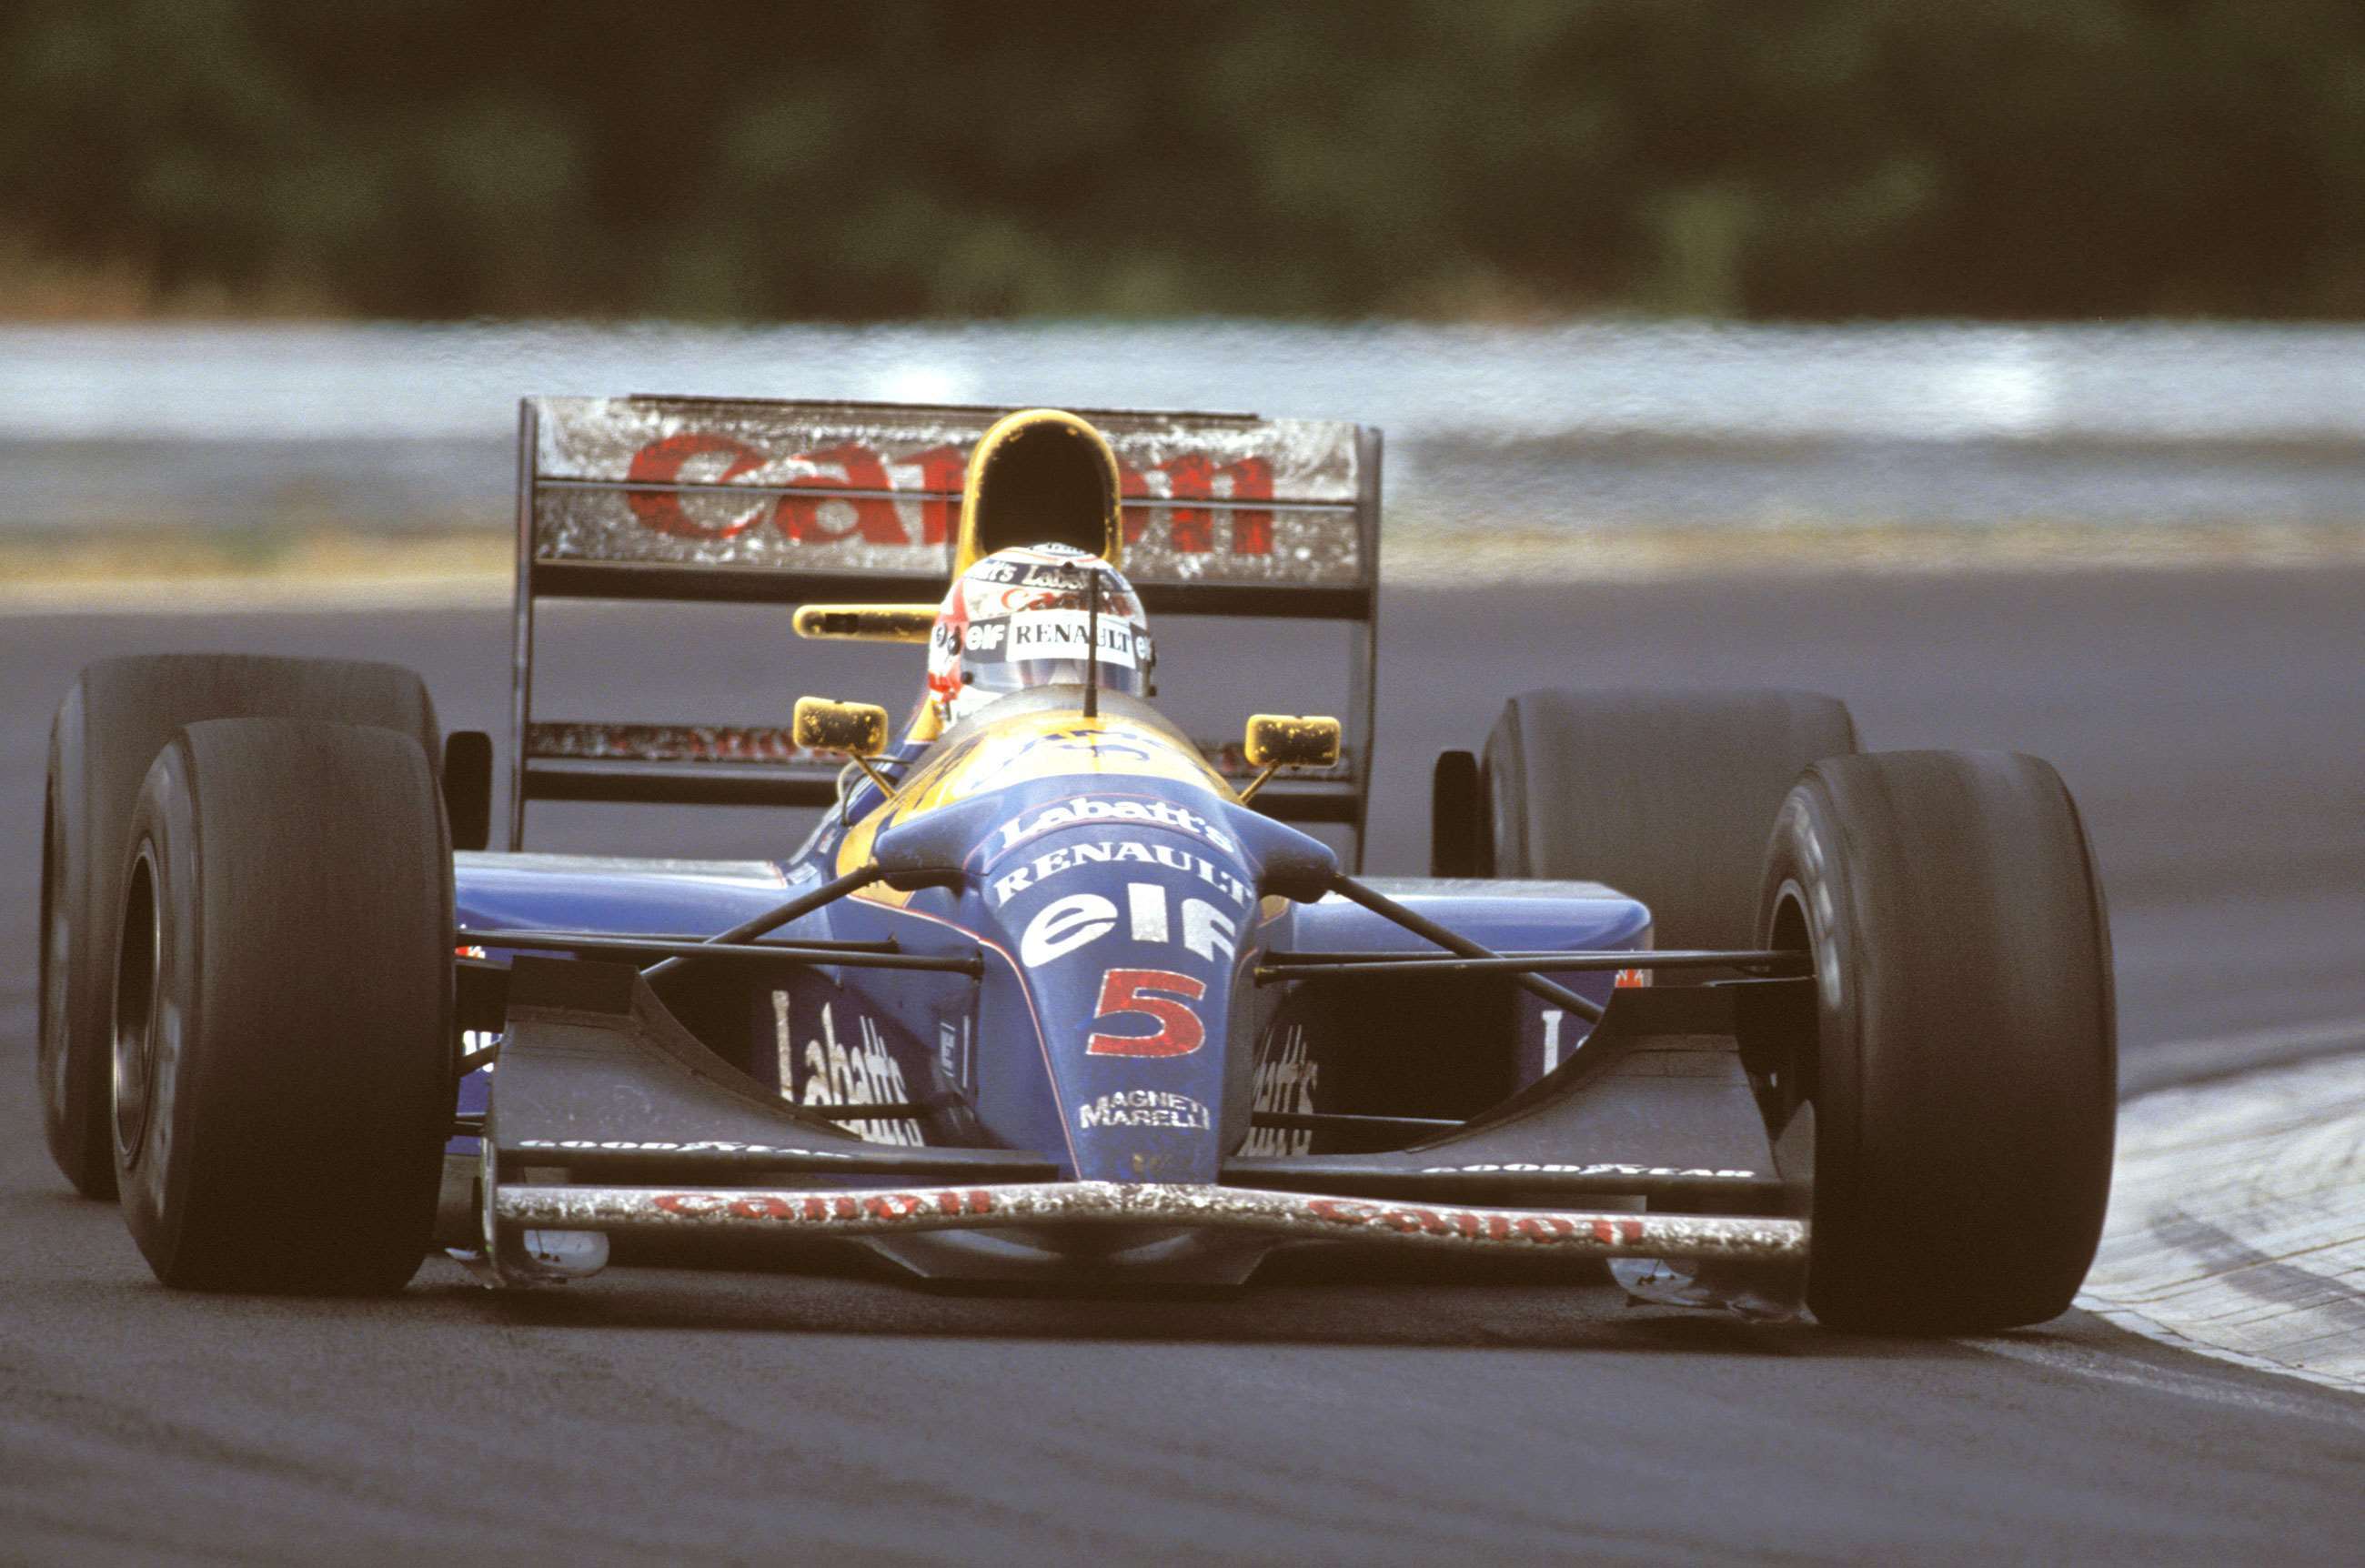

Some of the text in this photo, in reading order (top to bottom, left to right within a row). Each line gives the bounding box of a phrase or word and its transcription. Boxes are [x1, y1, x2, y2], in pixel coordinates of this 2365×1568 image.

[964, 623, 1005, 650] elf
[1000, 797, 1235, 854] Labatt's
[992, 841, 1253, 908] RENAULT
[1020, 882, 1237, 969] elf
[1086, 968, 1208, 1060] 5
